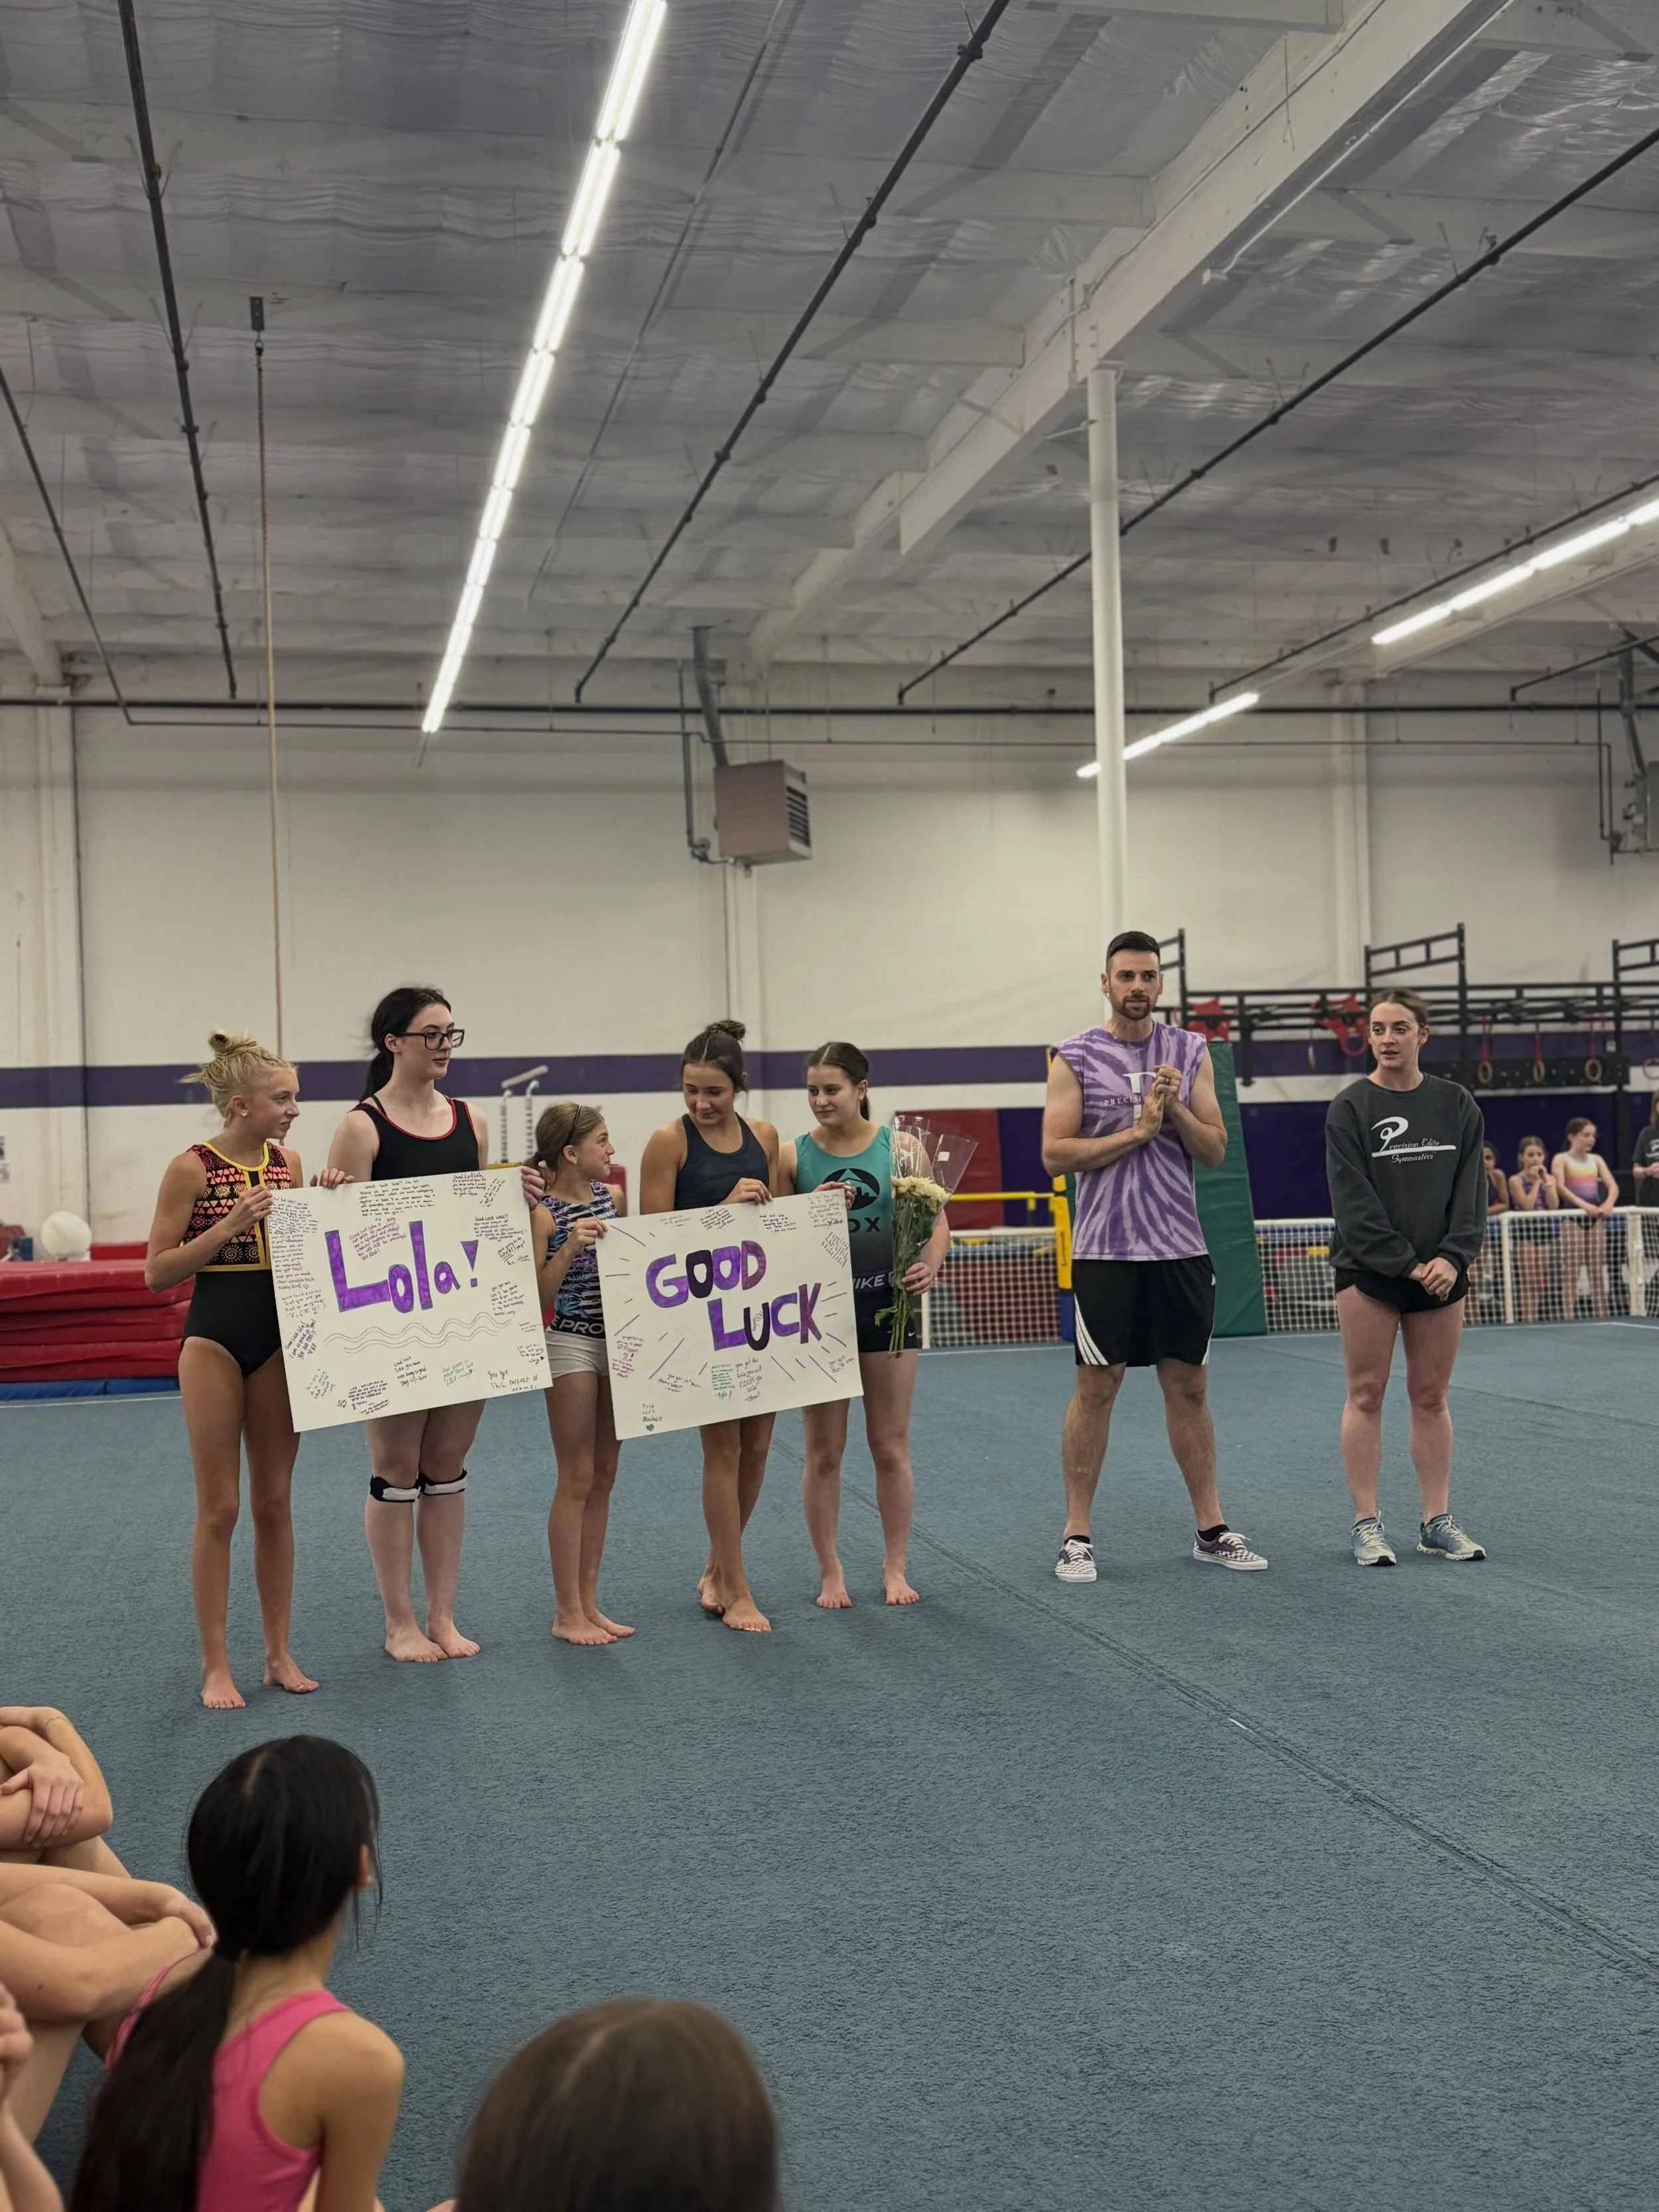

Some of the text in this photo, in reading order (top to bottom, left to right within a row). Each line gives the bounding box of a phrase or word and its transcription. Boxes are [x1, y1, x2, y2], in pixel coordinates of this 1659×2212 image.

[1421, 1138, 1440, 1147] Elite
[1391, 1153, 1433, 1165] Gymnastics
[324, 1219, 479, 1313] Lola!
[645, 1239, 767, 1308] GOOD
[853, 1274, 885, 1290] IKE
[707, 1282, 822, 1351] LUCK
[559, 1319, 604, 1335] PRO
